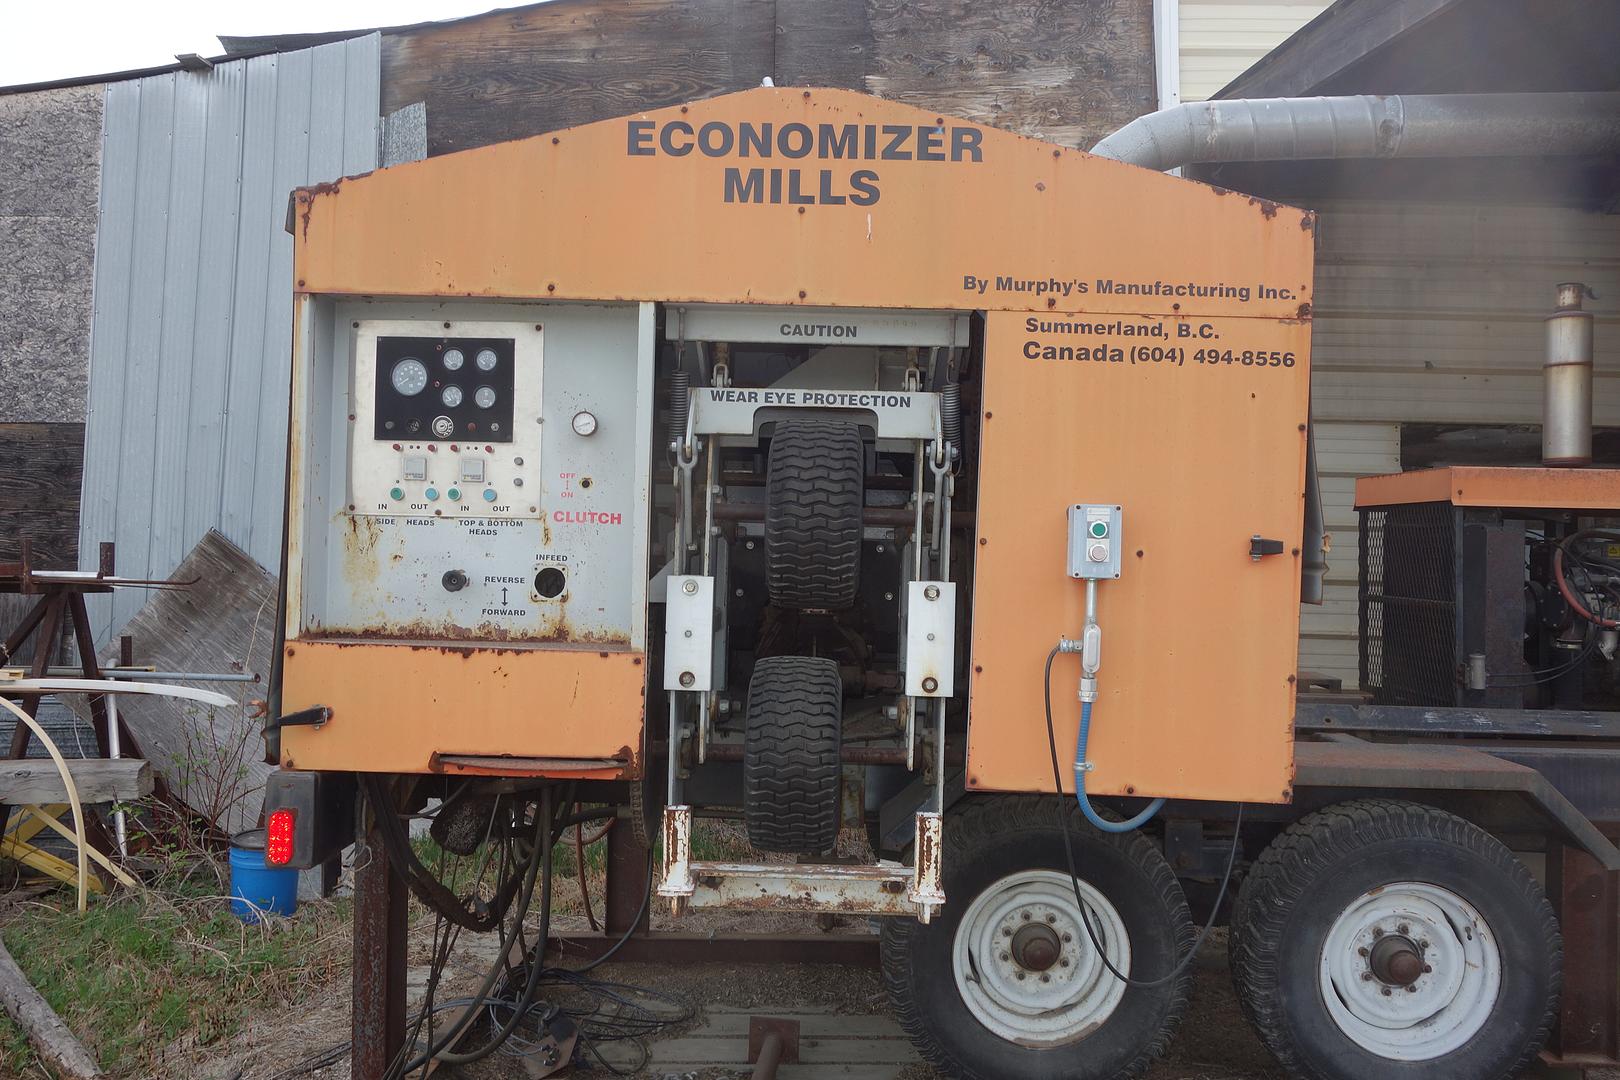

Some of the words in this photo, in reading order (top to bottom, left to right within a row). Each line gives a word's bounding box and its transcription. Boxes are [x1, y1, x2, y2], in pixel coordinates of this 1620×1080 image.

[627, 120, 984, 163] ECONOMIZER
[723, 167, 881, 207] MILLS
[963, 275, 989, 294] By
[995, 276, 1089, 297] Murphy's
[1096, 279, 1250, 302] Manufacturing
[1258, 284, 1297, 301] Inc.
[779, 323, 858, 338] CAUTION
[1025, 317, 1169, 340] Summerland,
[1177, 322, 1220, 340] B.C.
[1022, 340, 1124, 363] Canada
[1130, 346, 1185, 367] (604)
[1193, 348, 1296, 368] 494-8556
[709, 390, 759, 404] WEAR
[764, 391, 796, 405] EYE
[802, 392, 912, 408] PROTECTION
[559, 472, 577, 480] OFF
[377, 503, 388, 511] IN
[410, 503, 429, 511] OUT
[376, 518, 396, 526] SIDE
[406, 519, 435, 527] HEADS
[553, 510, 622, 525] CLUTCH
[458, 520, 476, 528] TOP
[478, 520, 486, 528] &
[487, 520, 523, 528] BOTTOM
[469, 528, 498, 536] HEADS
[535, 554, 568, 562] INFEED
[484, 576, 526, 584] REVERSE
[481, 608, 527, 617] FORWARD
